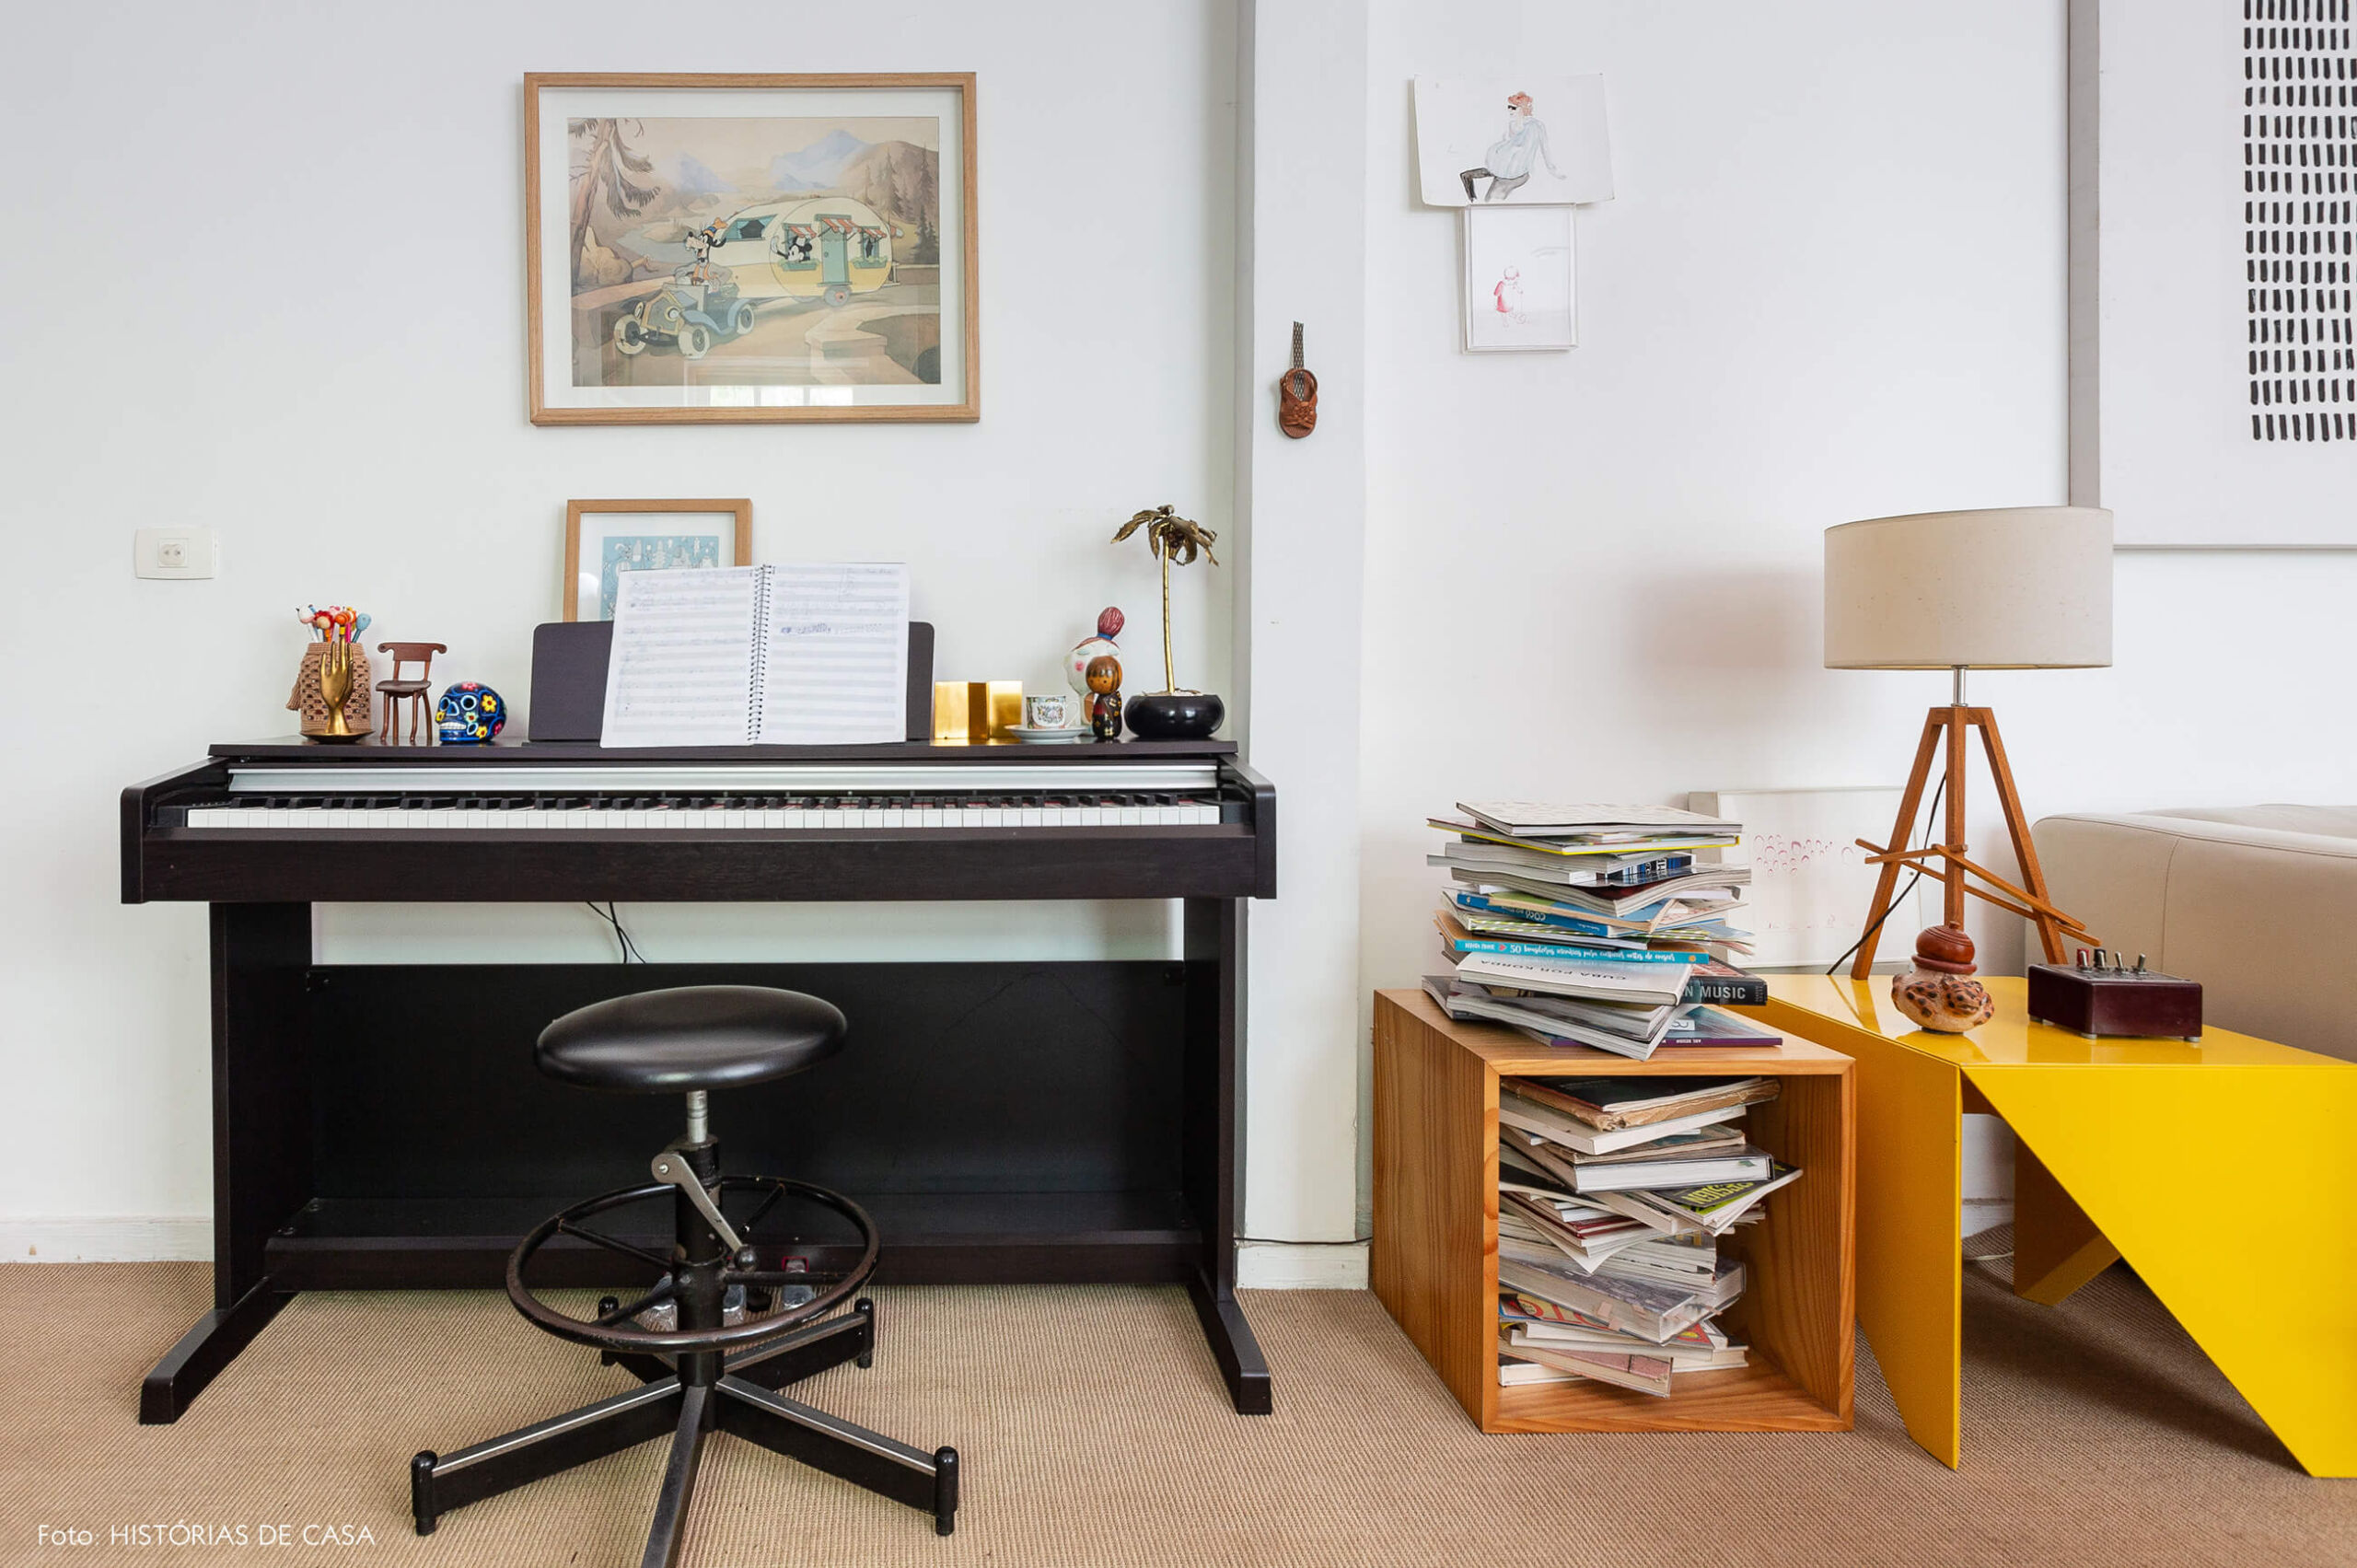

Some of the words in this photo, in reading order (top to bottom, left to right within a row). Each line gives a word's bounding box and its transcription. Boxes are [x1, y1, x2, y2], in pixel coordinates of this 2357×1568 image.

[1510, 944, 1522, 954] 50
[1480, 960, 1534, 970] KORDA
[1540, 967, 1573, 976] POR
[1580, 971, 1627, 981] CUBA
[1700, 985, 1746, 1000] MUSIC
